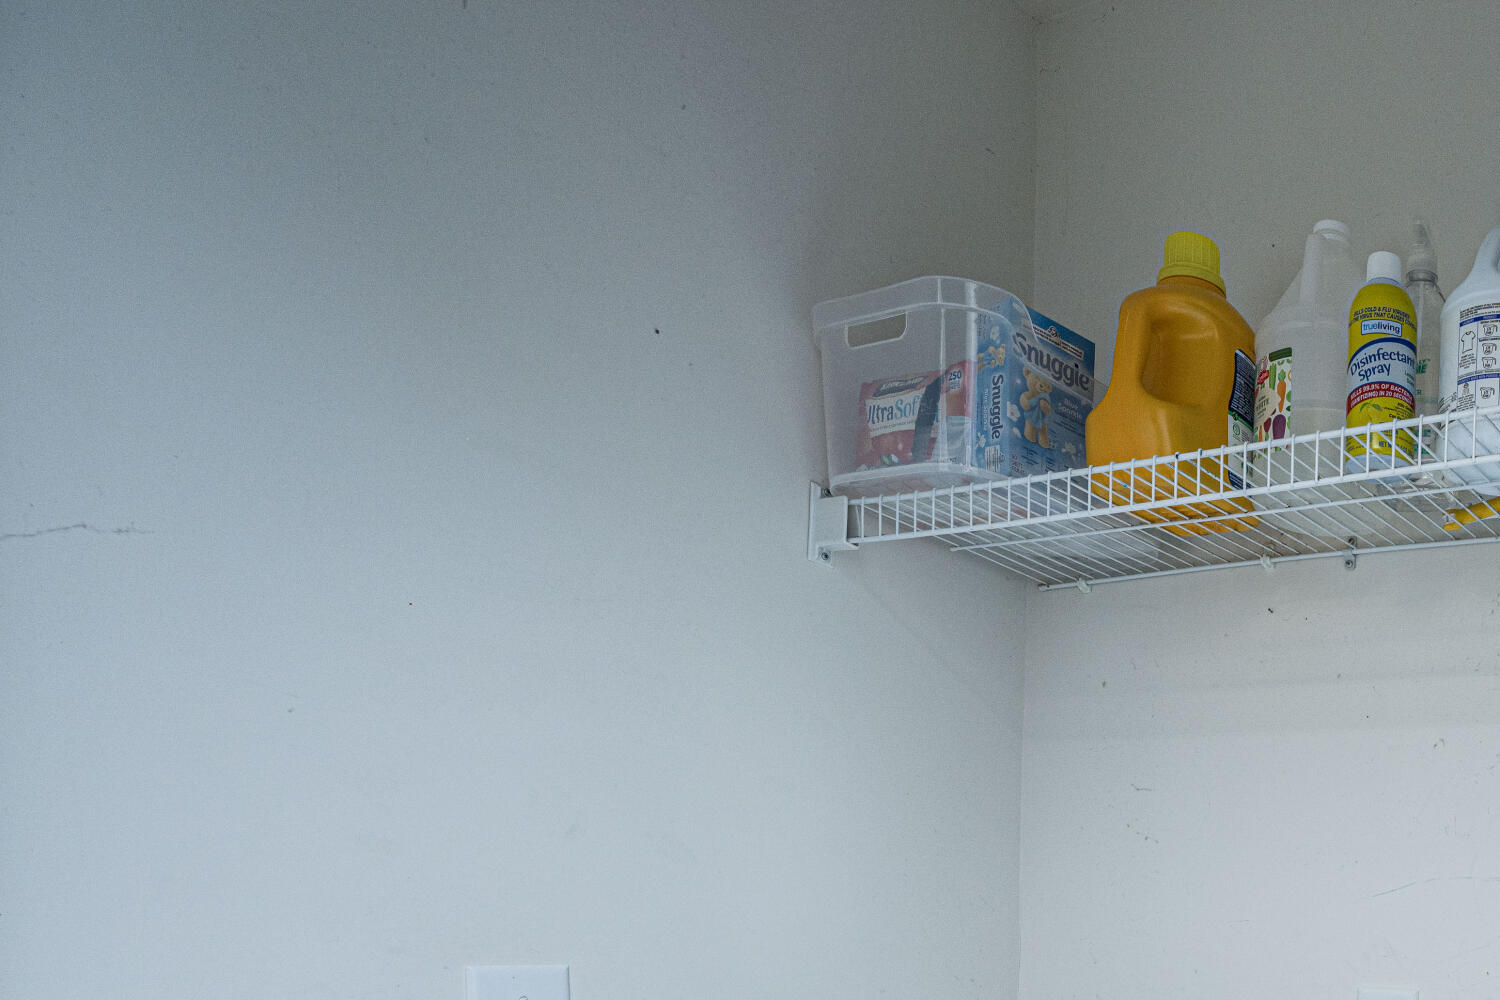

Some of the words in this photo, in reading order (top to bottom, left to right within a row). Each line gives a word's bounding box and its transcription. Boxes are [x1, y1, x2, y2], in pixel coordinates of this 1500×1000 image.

[1363, 322, 1401, 334] trueliving
[1358, 363, 1391, 381] Spray
[989, 374, 1004, 440] Snuggle
